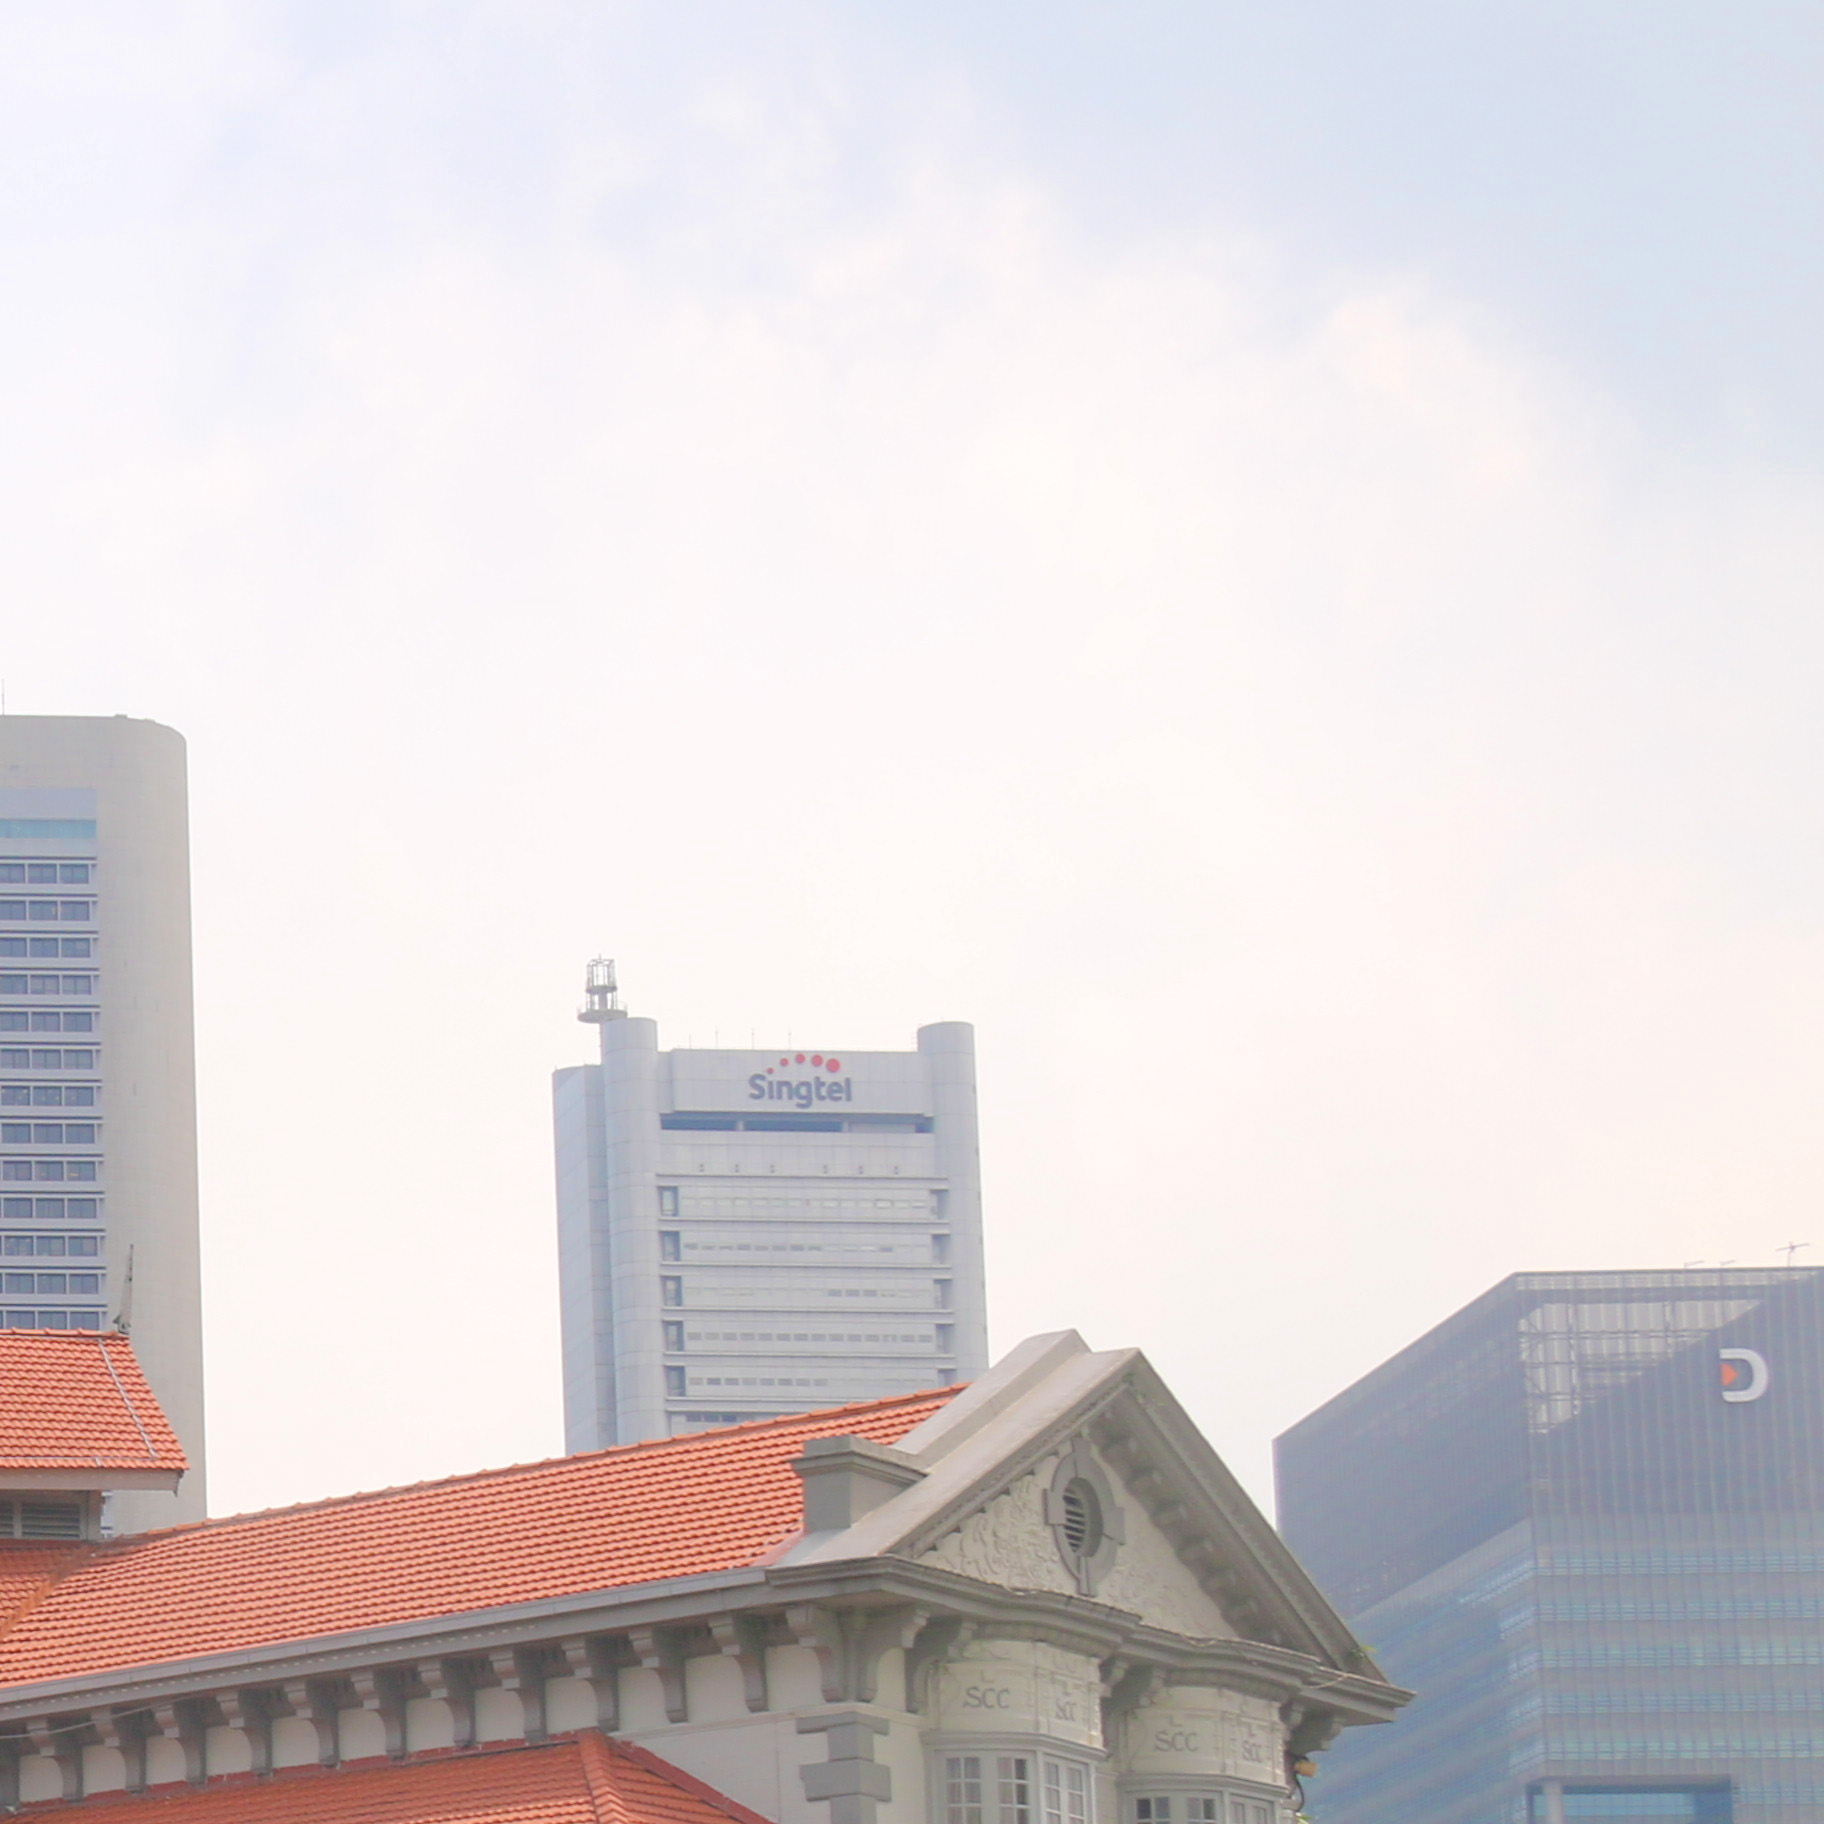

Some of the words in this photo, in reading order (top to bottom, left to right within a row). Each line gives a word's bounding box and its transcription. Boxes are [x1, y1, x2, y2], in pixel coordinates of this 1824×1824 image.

[748, 1071, 852, 1109] Singtel
[962, 1686, 1010, 1709] SCC
[1154, 1730, 1199, 1752] SCC
